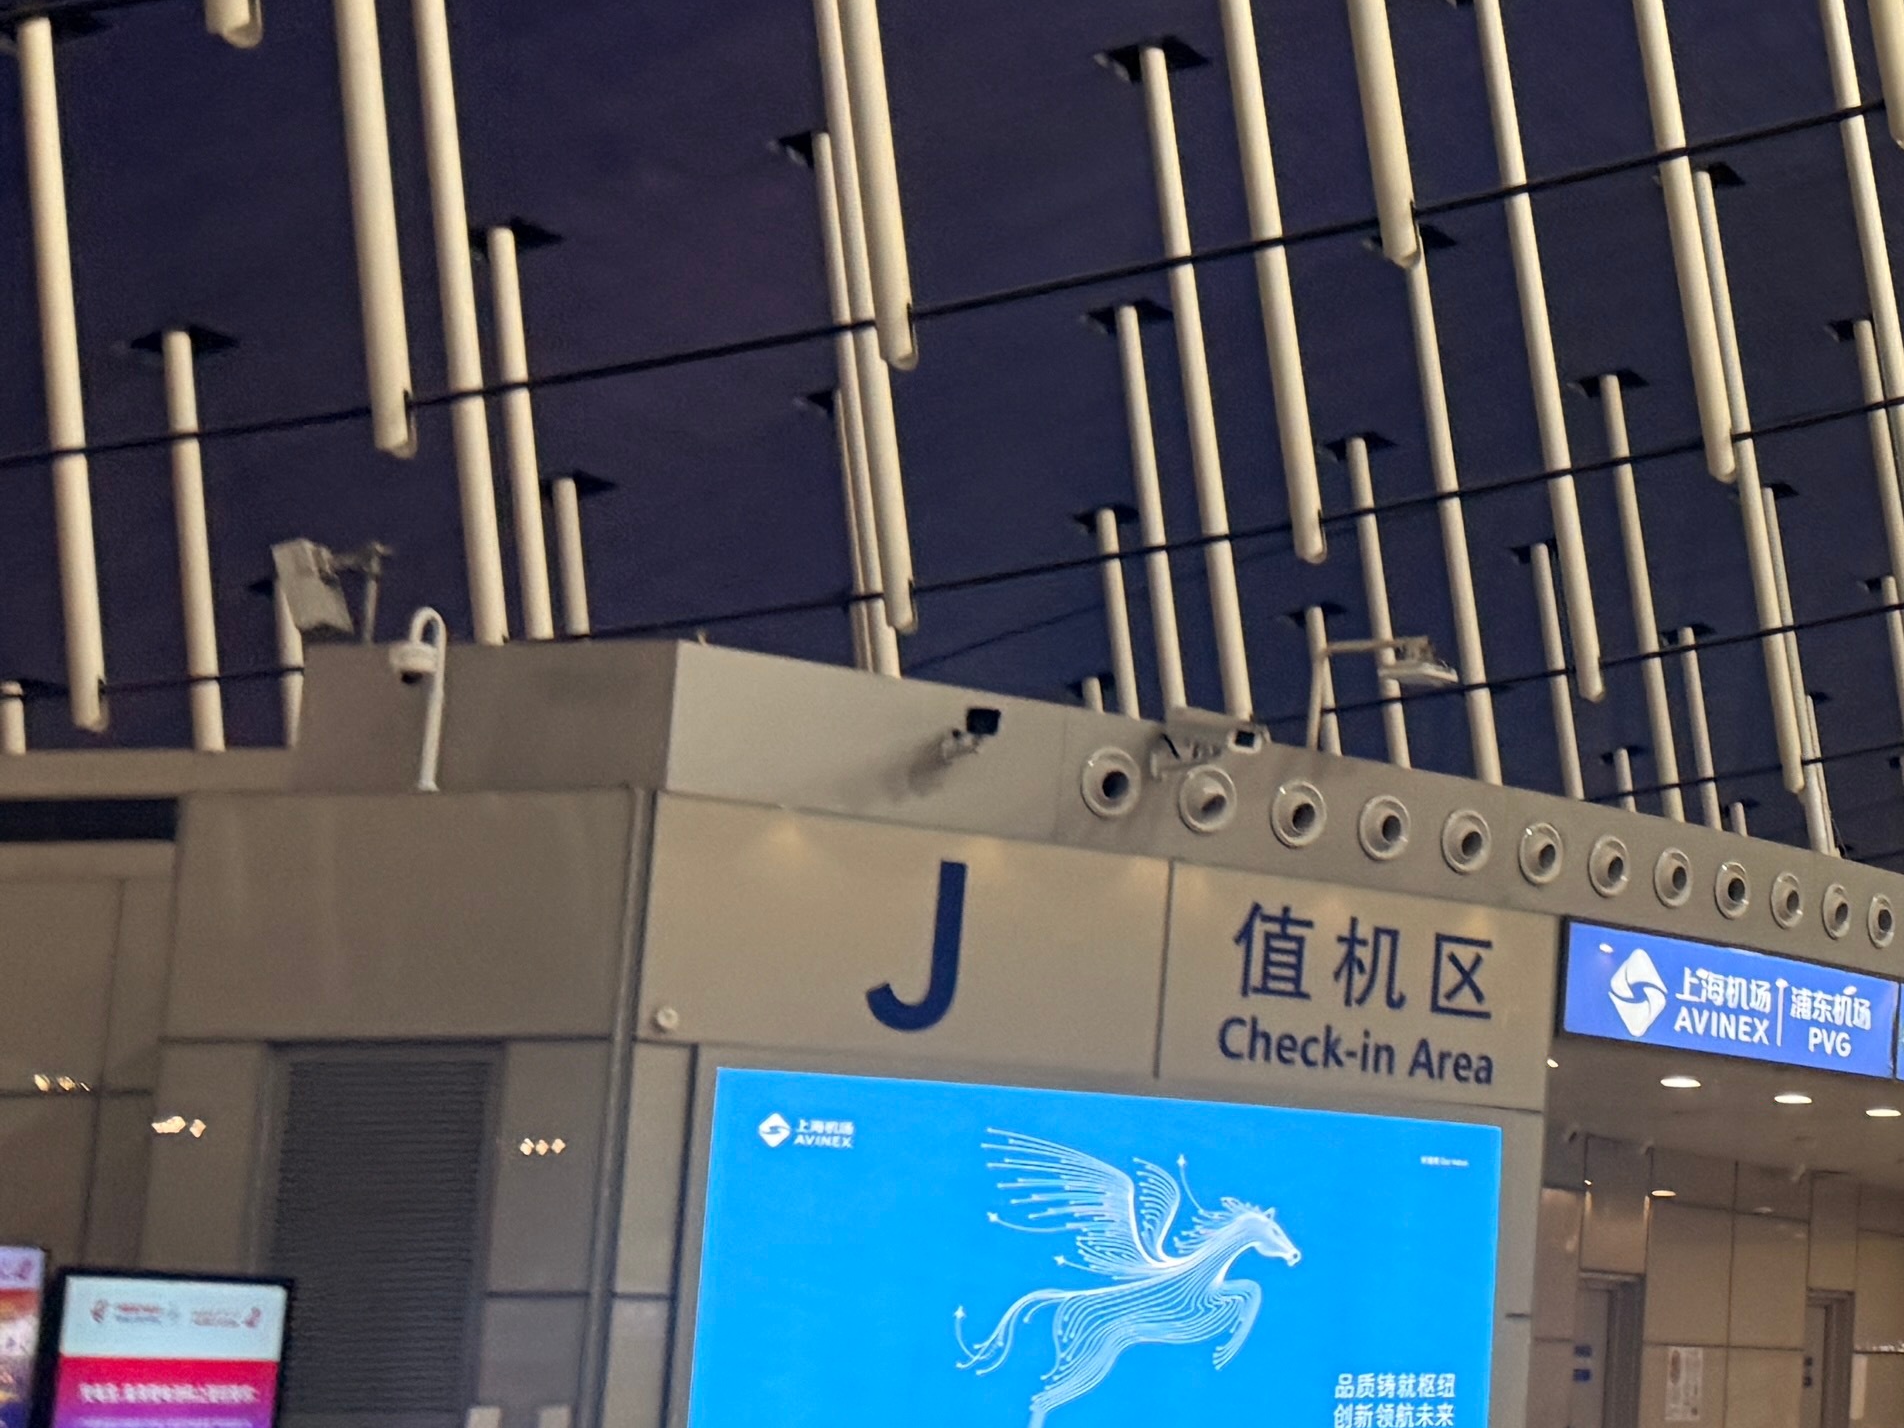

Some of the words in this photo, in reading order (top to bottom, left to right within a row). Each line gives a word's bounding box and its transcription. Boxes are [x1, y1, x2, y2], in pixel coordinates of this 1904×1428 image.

[866, 859, 967, 1031] J
[1233, 902, 1493, 1020] 值机区
[1675, 967, 1772, 1013] 上海机场
[1790, 986, 1872, 1031] 浦东机场
[1674, 1006, 1771, 1046] AVINEX
[1808, 1027, 1852, 1057] PVG
[1218, 1017, 1398, 1077] Check-in
[1409, 1038, 1494, 1086] Area
[793, 1133, 854, 1149] AVINEX
[1334, 1372, 1456, 1399] 品质铸就枢纽
